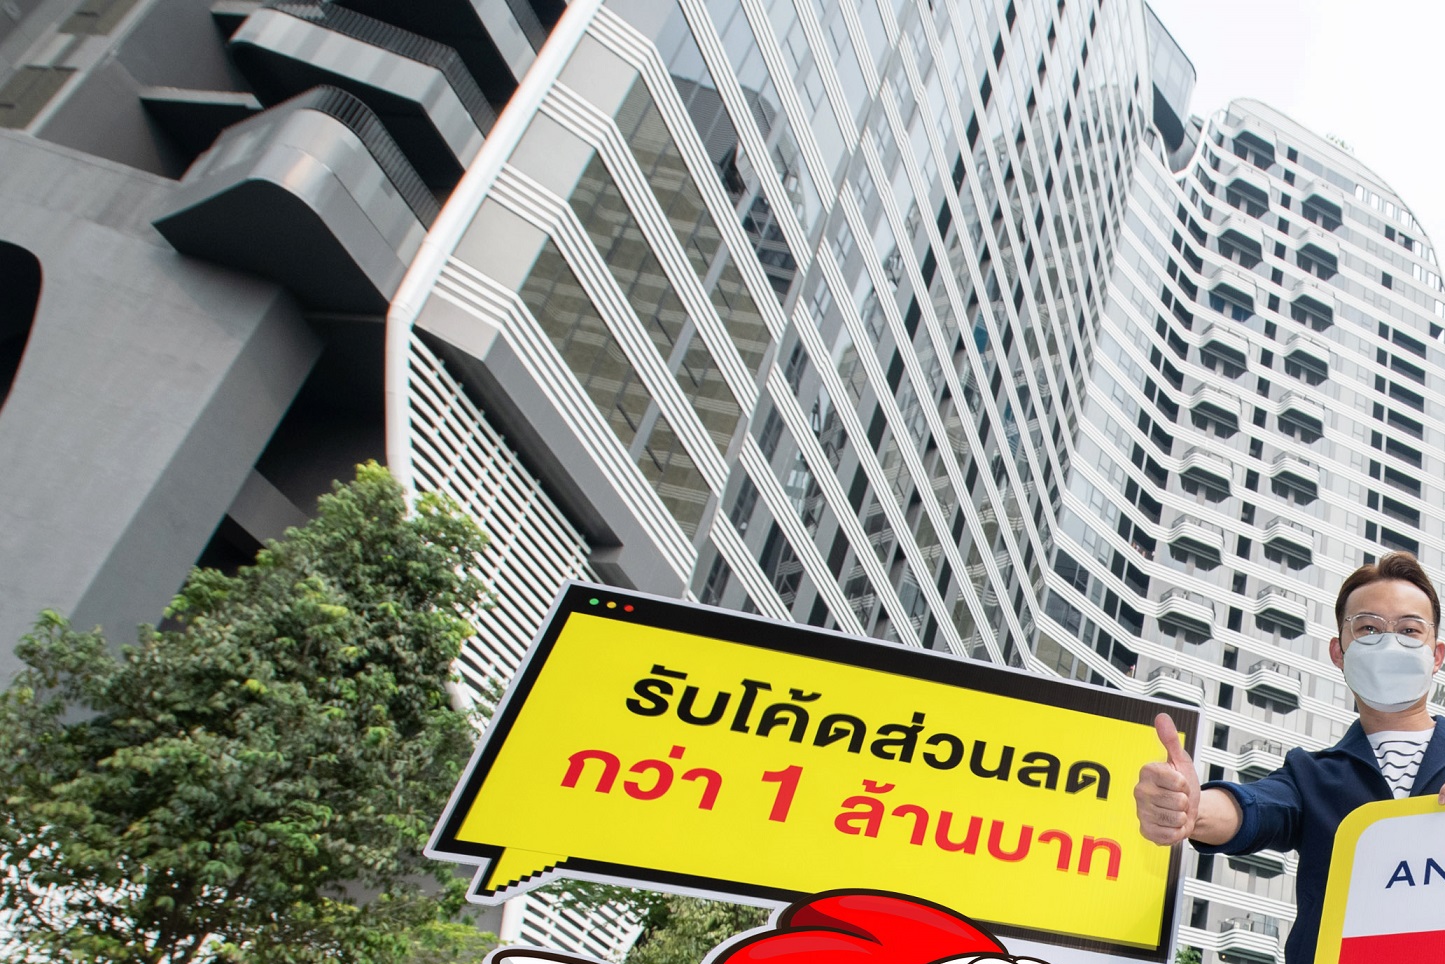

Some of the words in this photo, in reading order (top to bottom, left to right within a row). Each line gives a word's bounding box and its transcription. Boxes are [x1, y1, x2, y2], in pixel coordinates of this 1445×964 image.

[626, 664, 1111, 801] รับโค้ดส่วนลด
[560, 745, 722, 811] กว่า
[761, 764, 803, 824] 1
[834, 779, 1122, 881] ล้านบาท
